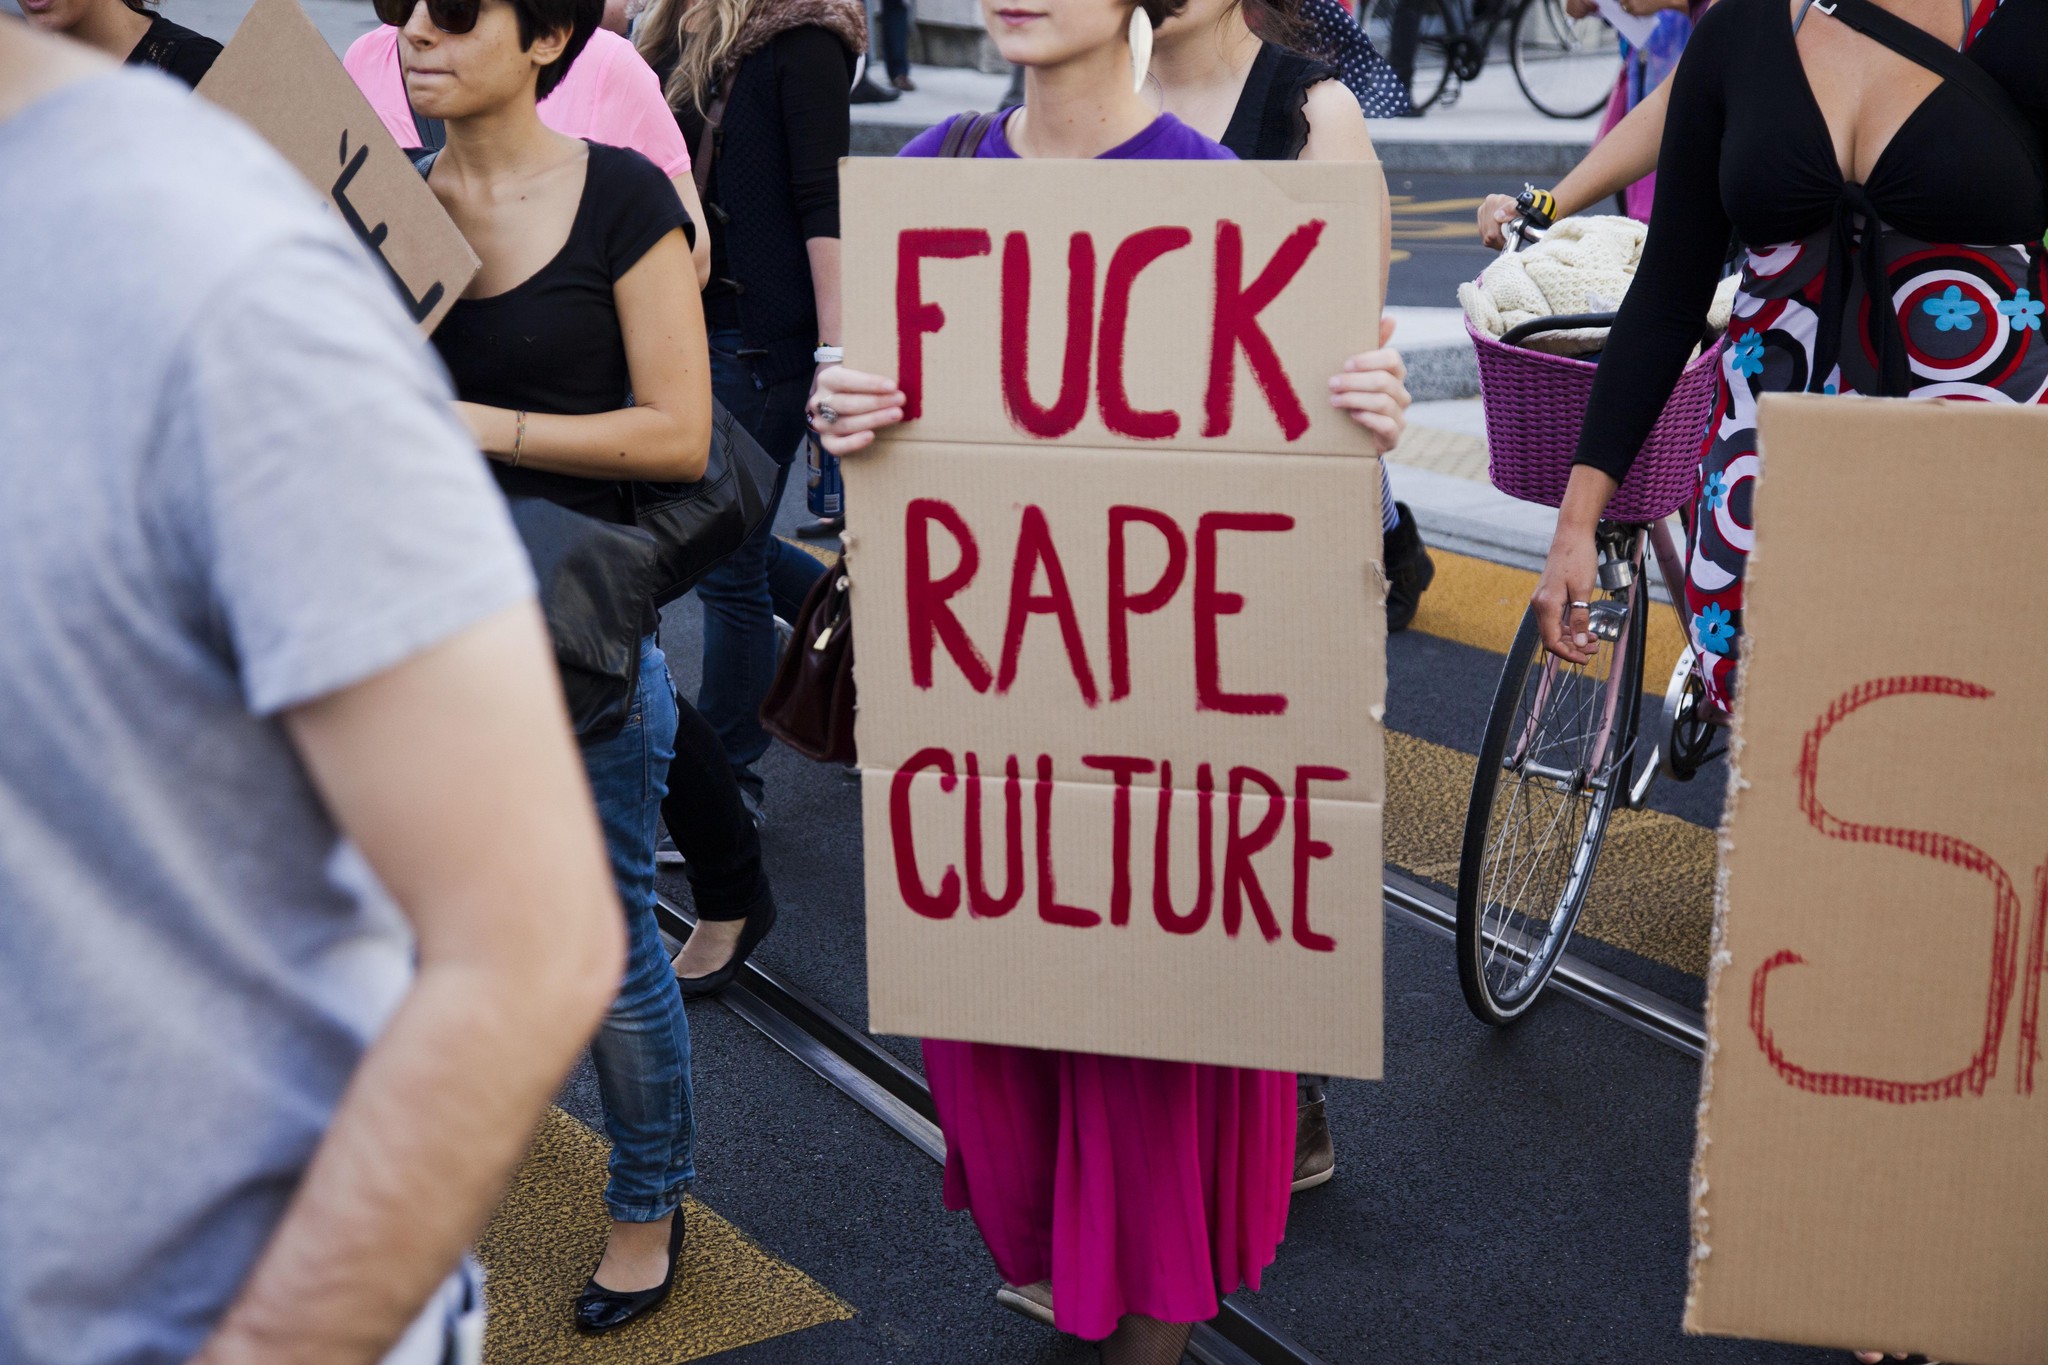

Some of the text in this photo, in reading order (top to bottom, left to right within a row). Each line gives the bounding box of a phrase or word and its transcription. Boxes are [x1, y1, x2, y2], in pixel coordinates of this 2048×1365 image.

[896, 219, 1326, 442] FUCK
[905, 498, 1295, 715] RAPE
[889, 747, 1349, 952] CULTURE
[1750, 674, 2048, 1103] S
